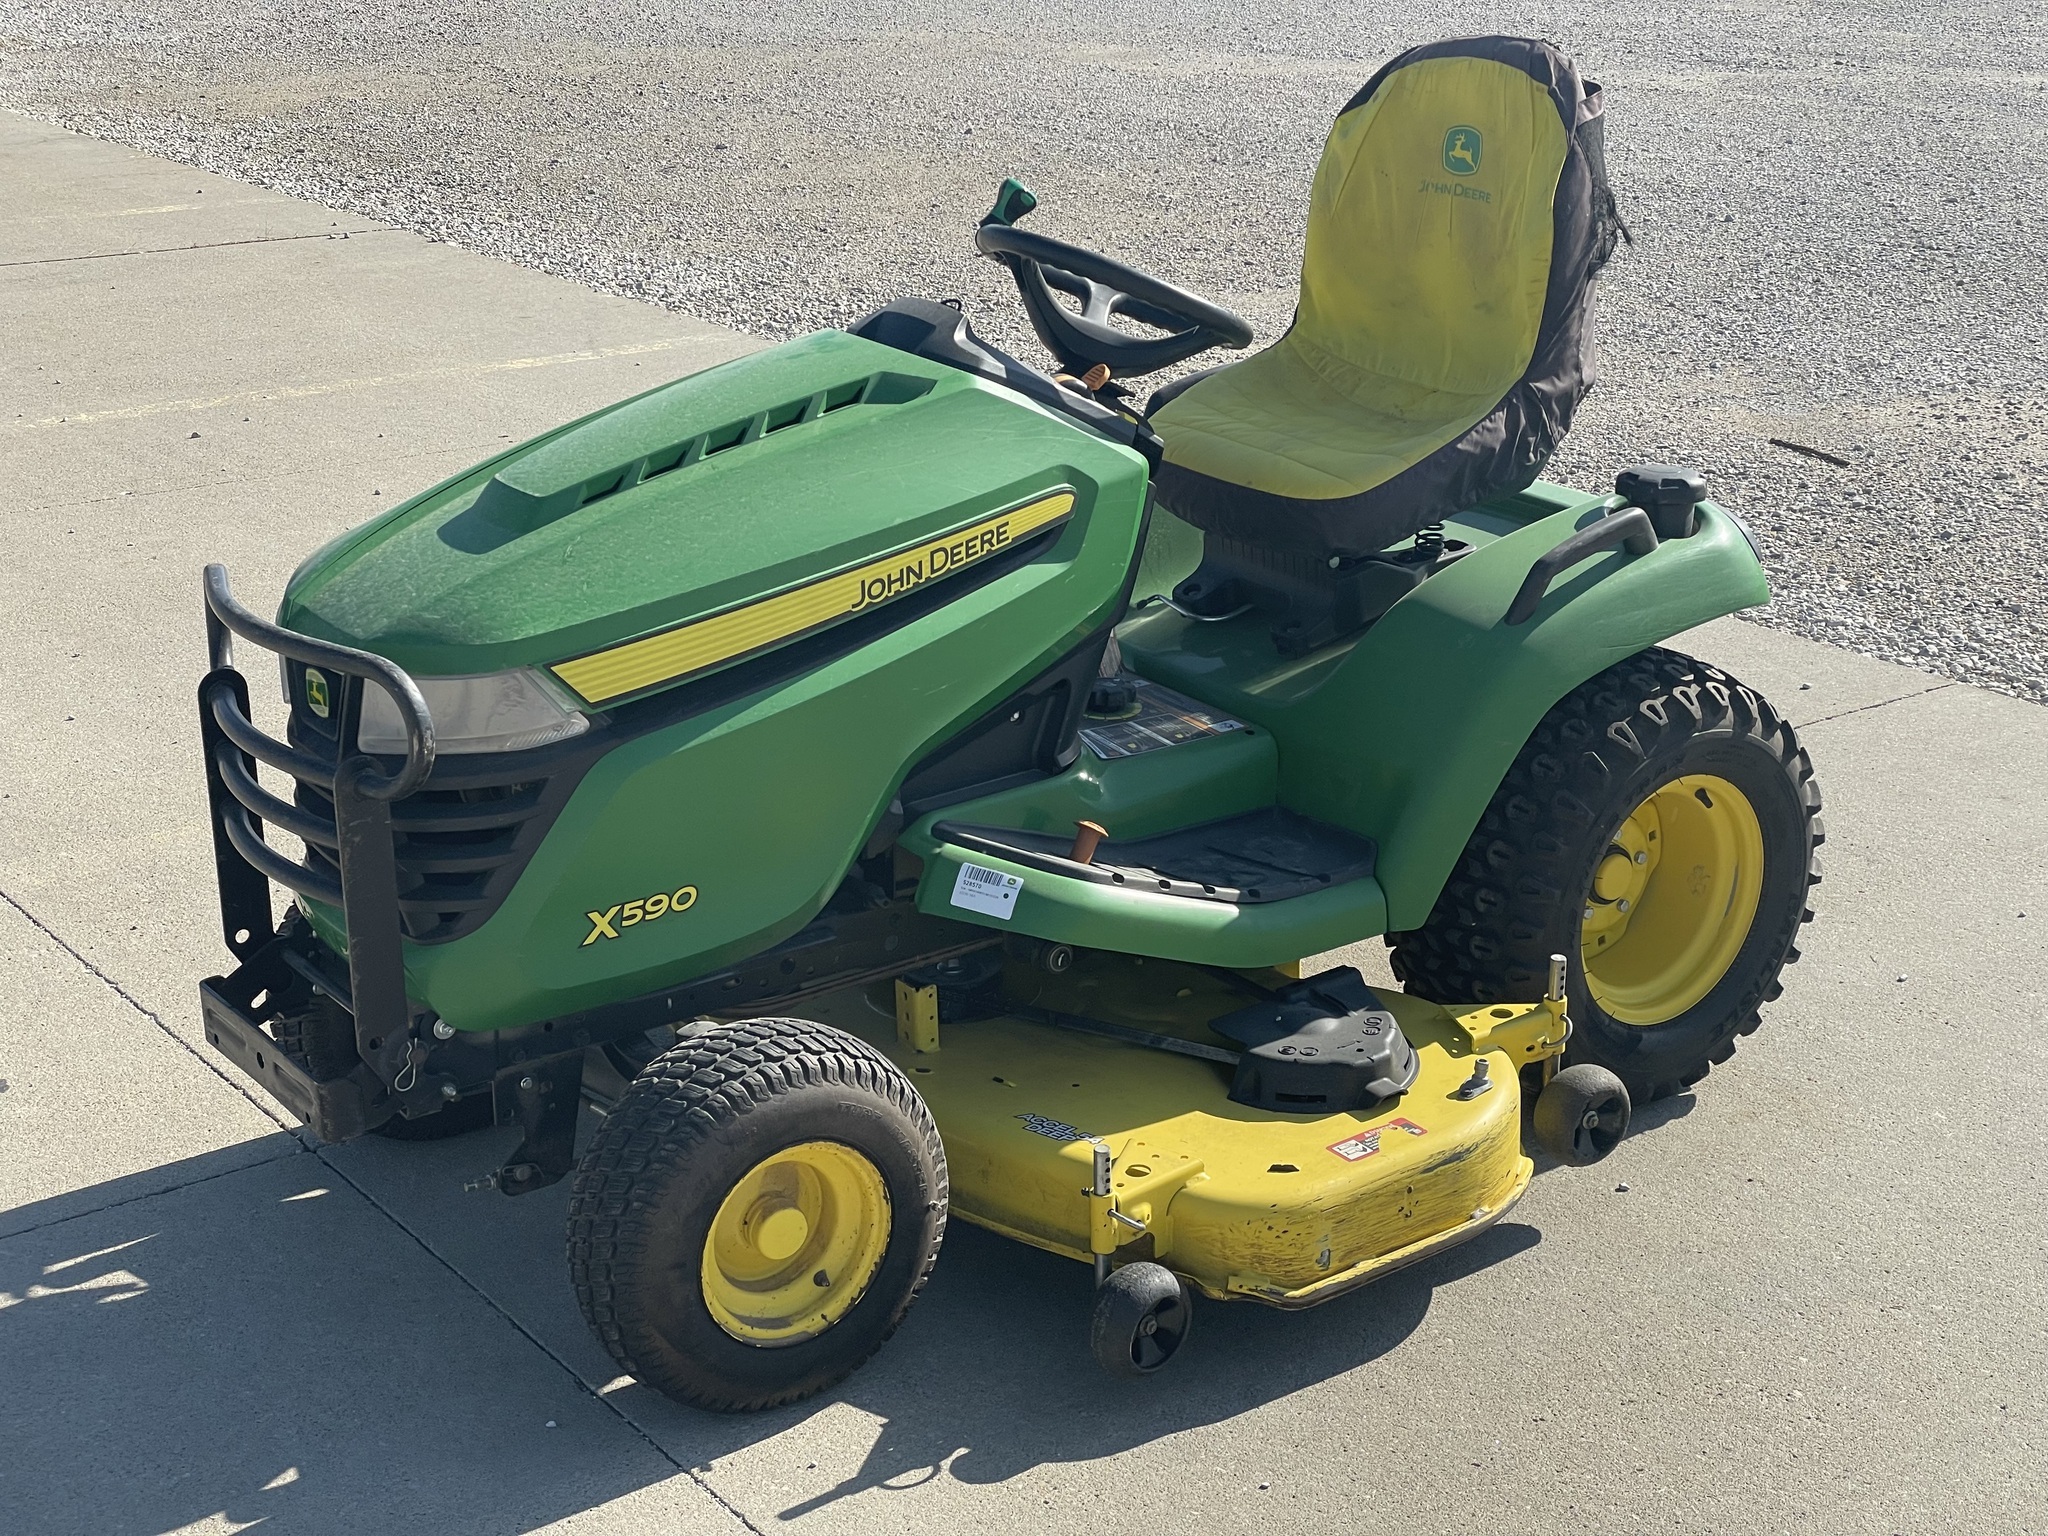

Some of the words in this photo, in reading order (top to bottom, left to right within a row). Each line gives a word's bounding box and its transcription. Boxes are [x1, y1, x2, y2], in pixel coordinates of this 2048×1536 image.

[1454, 183, 1492, 204] DEERE
[851, 559, 924, 610] JOHN
[929, 521, 1011, 577] DEERE
[578, 885, 699, 949] X590
[1014, 1113, 1078, 1137] ACCEL
[1022, 1123, 1079, 1142] DEEP
